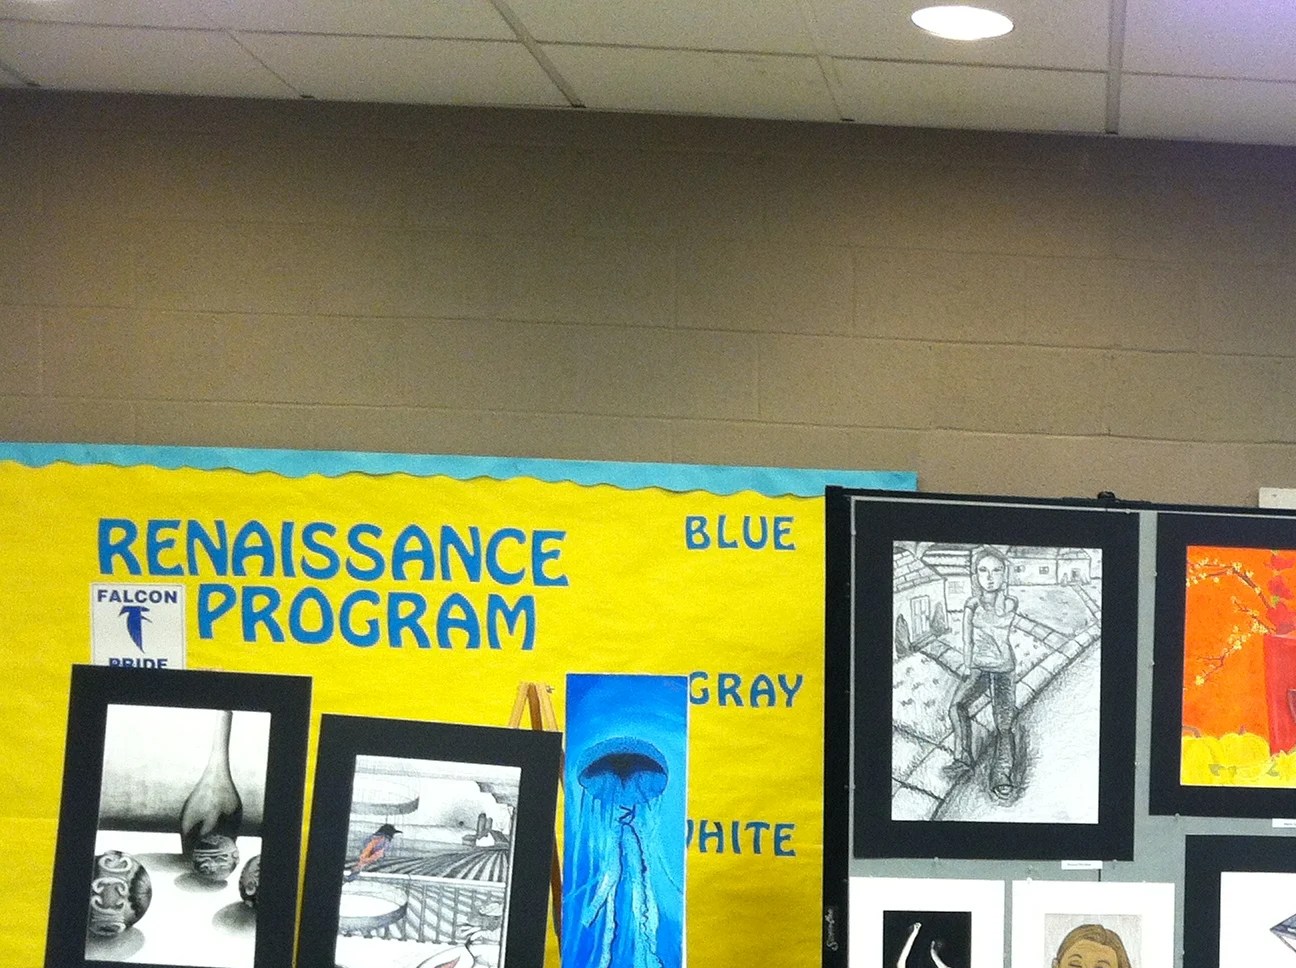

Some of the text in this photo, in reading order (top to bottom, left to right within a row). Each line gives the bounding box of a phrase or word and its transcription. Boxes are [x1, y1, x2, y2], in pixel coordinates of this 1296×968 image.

[685, 514, 796, 551] BLUE
[98, 517, 569, 587] RENAISSANCE
[97, 589, 178, 603] FALCON
[198, 583, 536, 651] PROGRAM
[689, 671, 804, 708] GRAY
